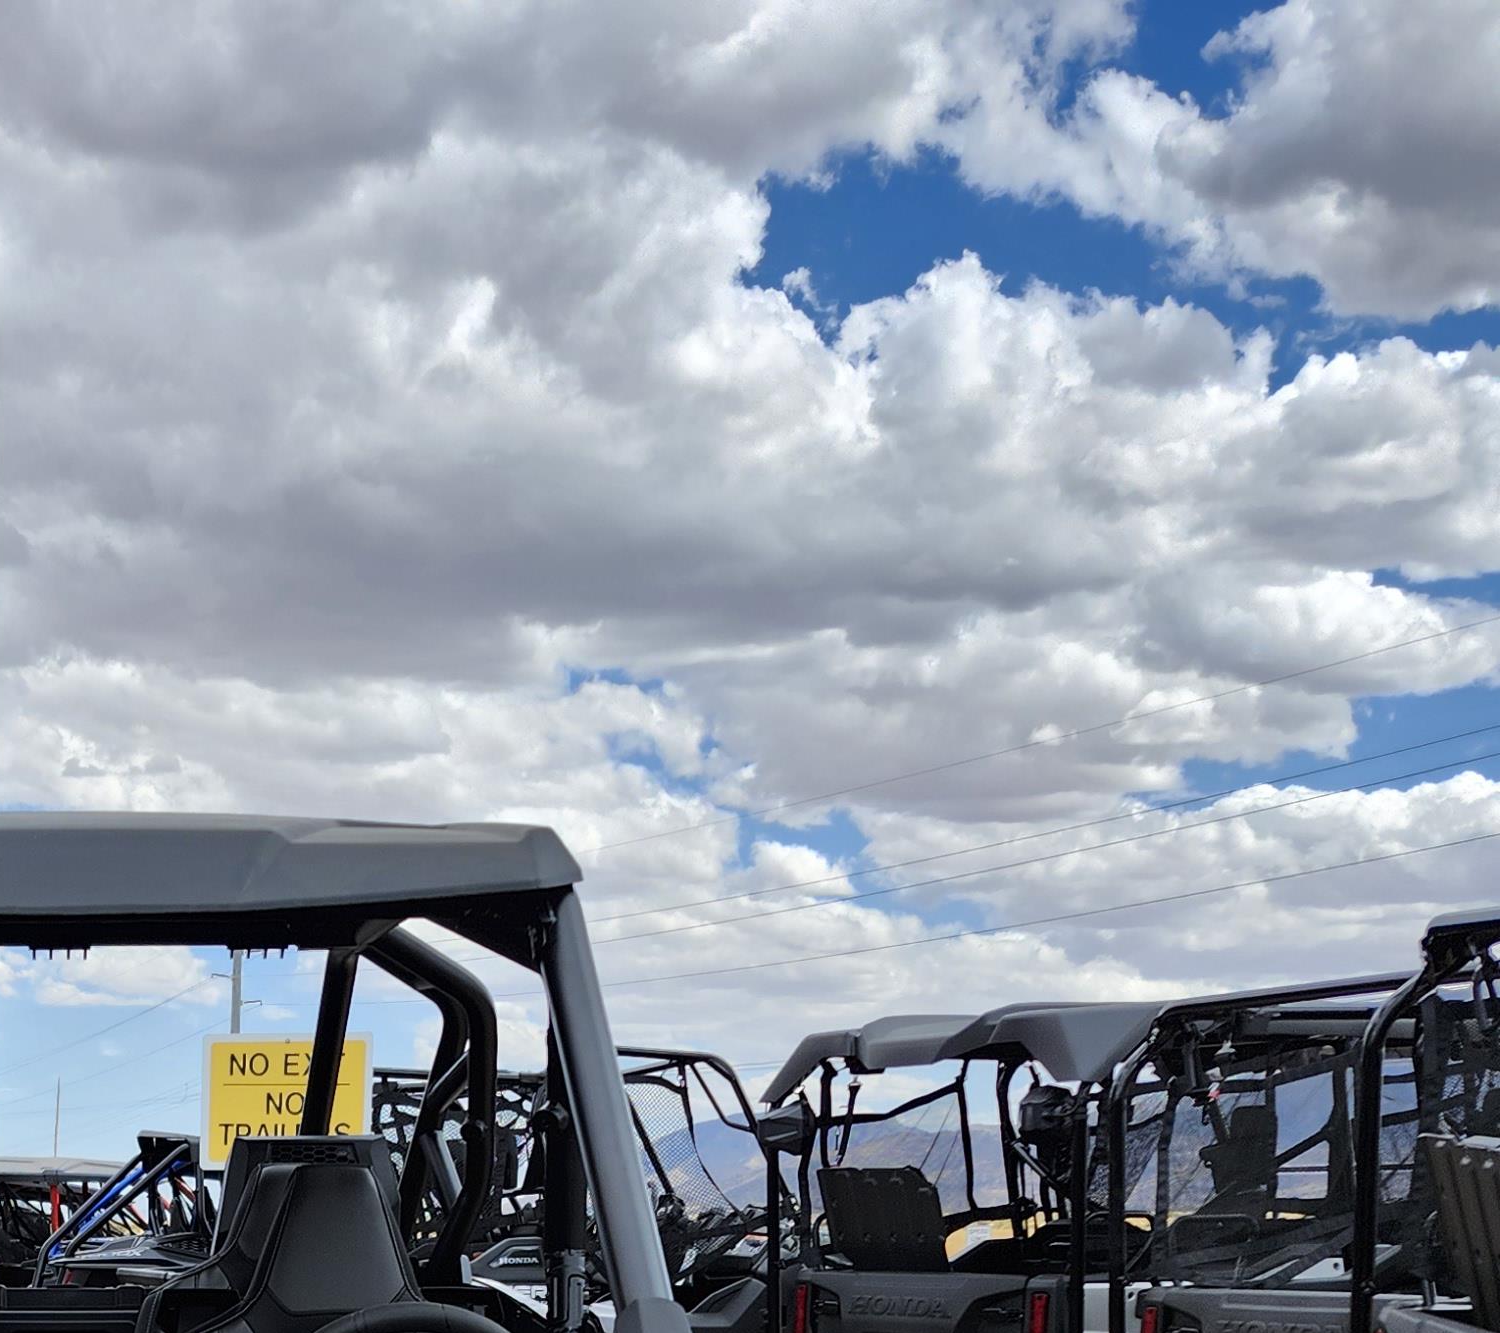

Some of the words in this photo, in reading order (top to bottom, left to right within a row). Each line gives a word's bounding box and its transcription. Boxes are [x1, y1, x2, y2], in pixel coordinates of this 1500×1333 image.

[229, 1053, 269, 1076] NO
[284, 1053, 345, 1076] EX
[266, 1092, 304, 1115] NO
[219, 1123, 350, 1145] TRAIS
[498, 1256, 539, 1265] HONDA
[848, 1295, 953, 1319] HONDA
